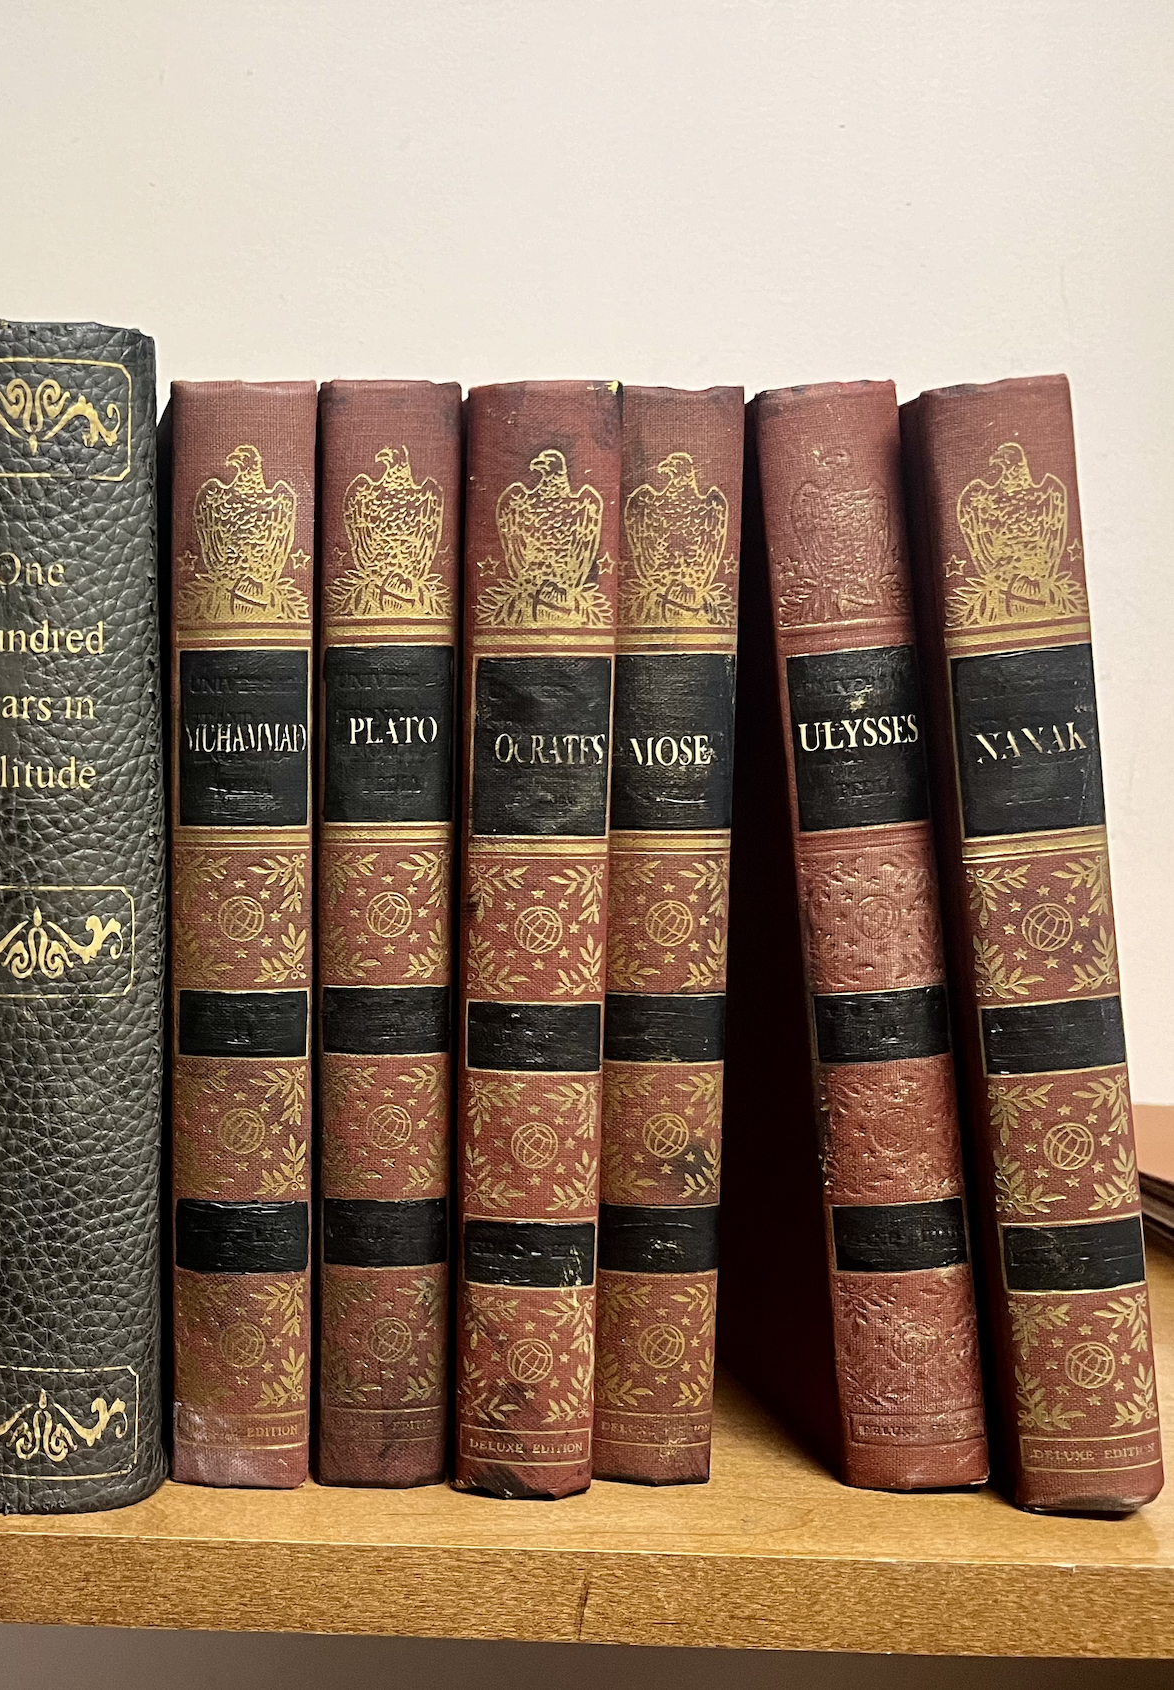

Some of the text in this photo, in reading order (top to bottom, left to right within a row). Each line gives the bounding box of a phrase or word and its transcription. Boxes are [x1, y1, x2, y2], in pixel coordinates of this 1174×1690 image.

[64, 695, 95, 720] in
[349, 716, 438, 745] PLATO
[797, 713, 919, 752] ULYSSES
[488, 733, 606, 765] OCRATES
[629, 734, 716, 767] MOSE
[246, 1424, 299, 1438] EDITION
[469, 1437, 584, 1455] DELUXE EDITION
